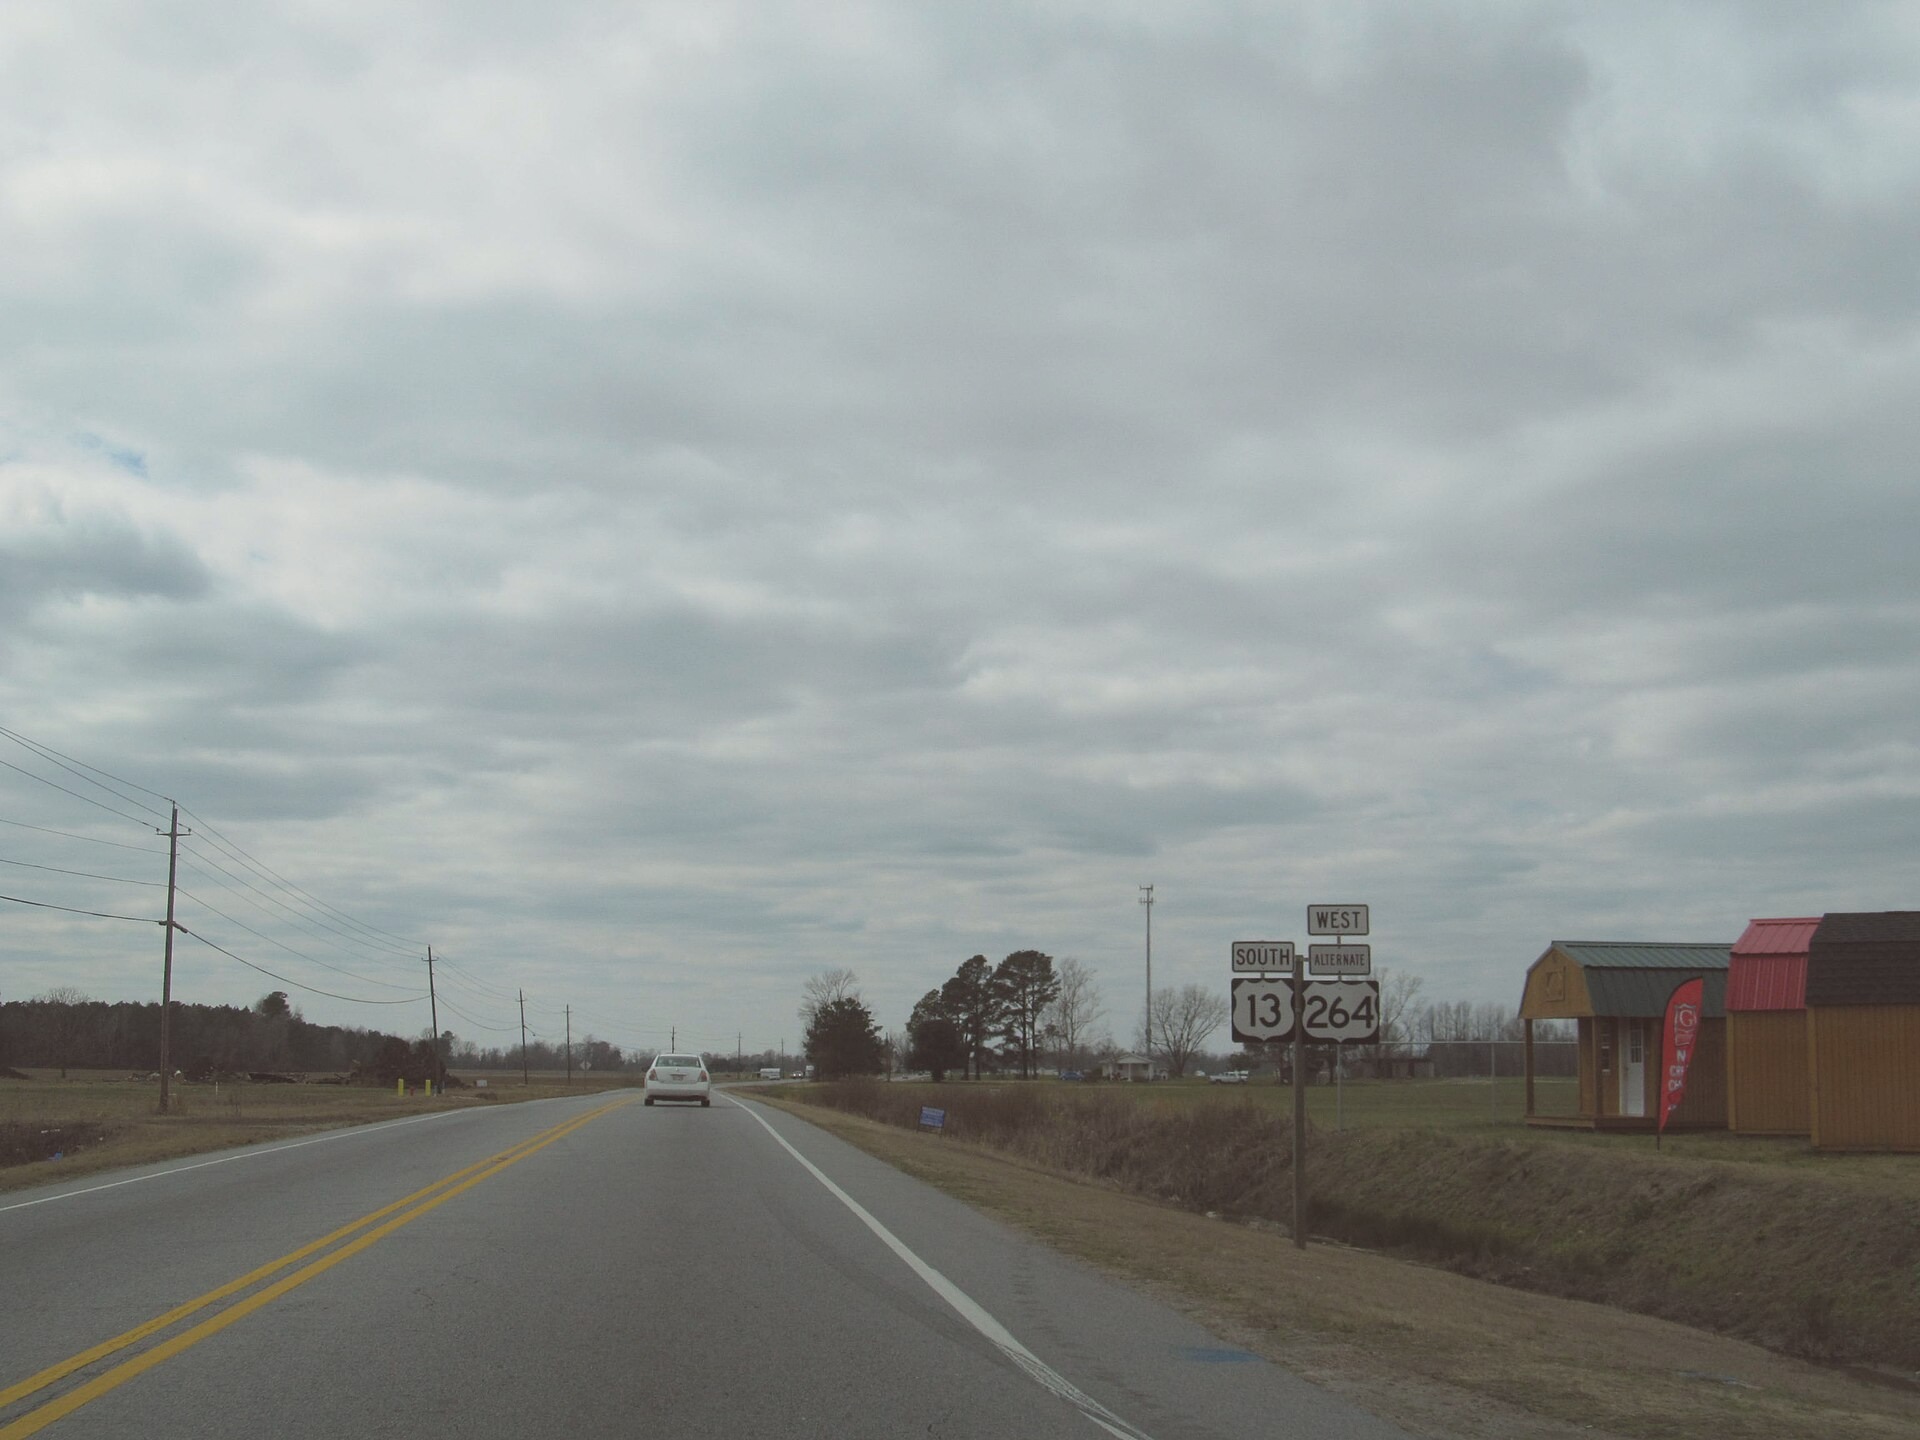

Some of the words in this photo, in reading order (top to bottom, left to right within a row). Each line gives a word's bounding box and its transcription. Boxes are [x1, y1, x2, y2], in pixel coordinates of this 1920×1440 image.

[1316, 911, 1361, 929] WEST
[1236, 948, 1290, 966] SOUTH
[1314, 953, 1365, 966] ALTERNATE
[1247, 993, 1282, 1028] 13
[1306, 995, 1375, 1028] 264
